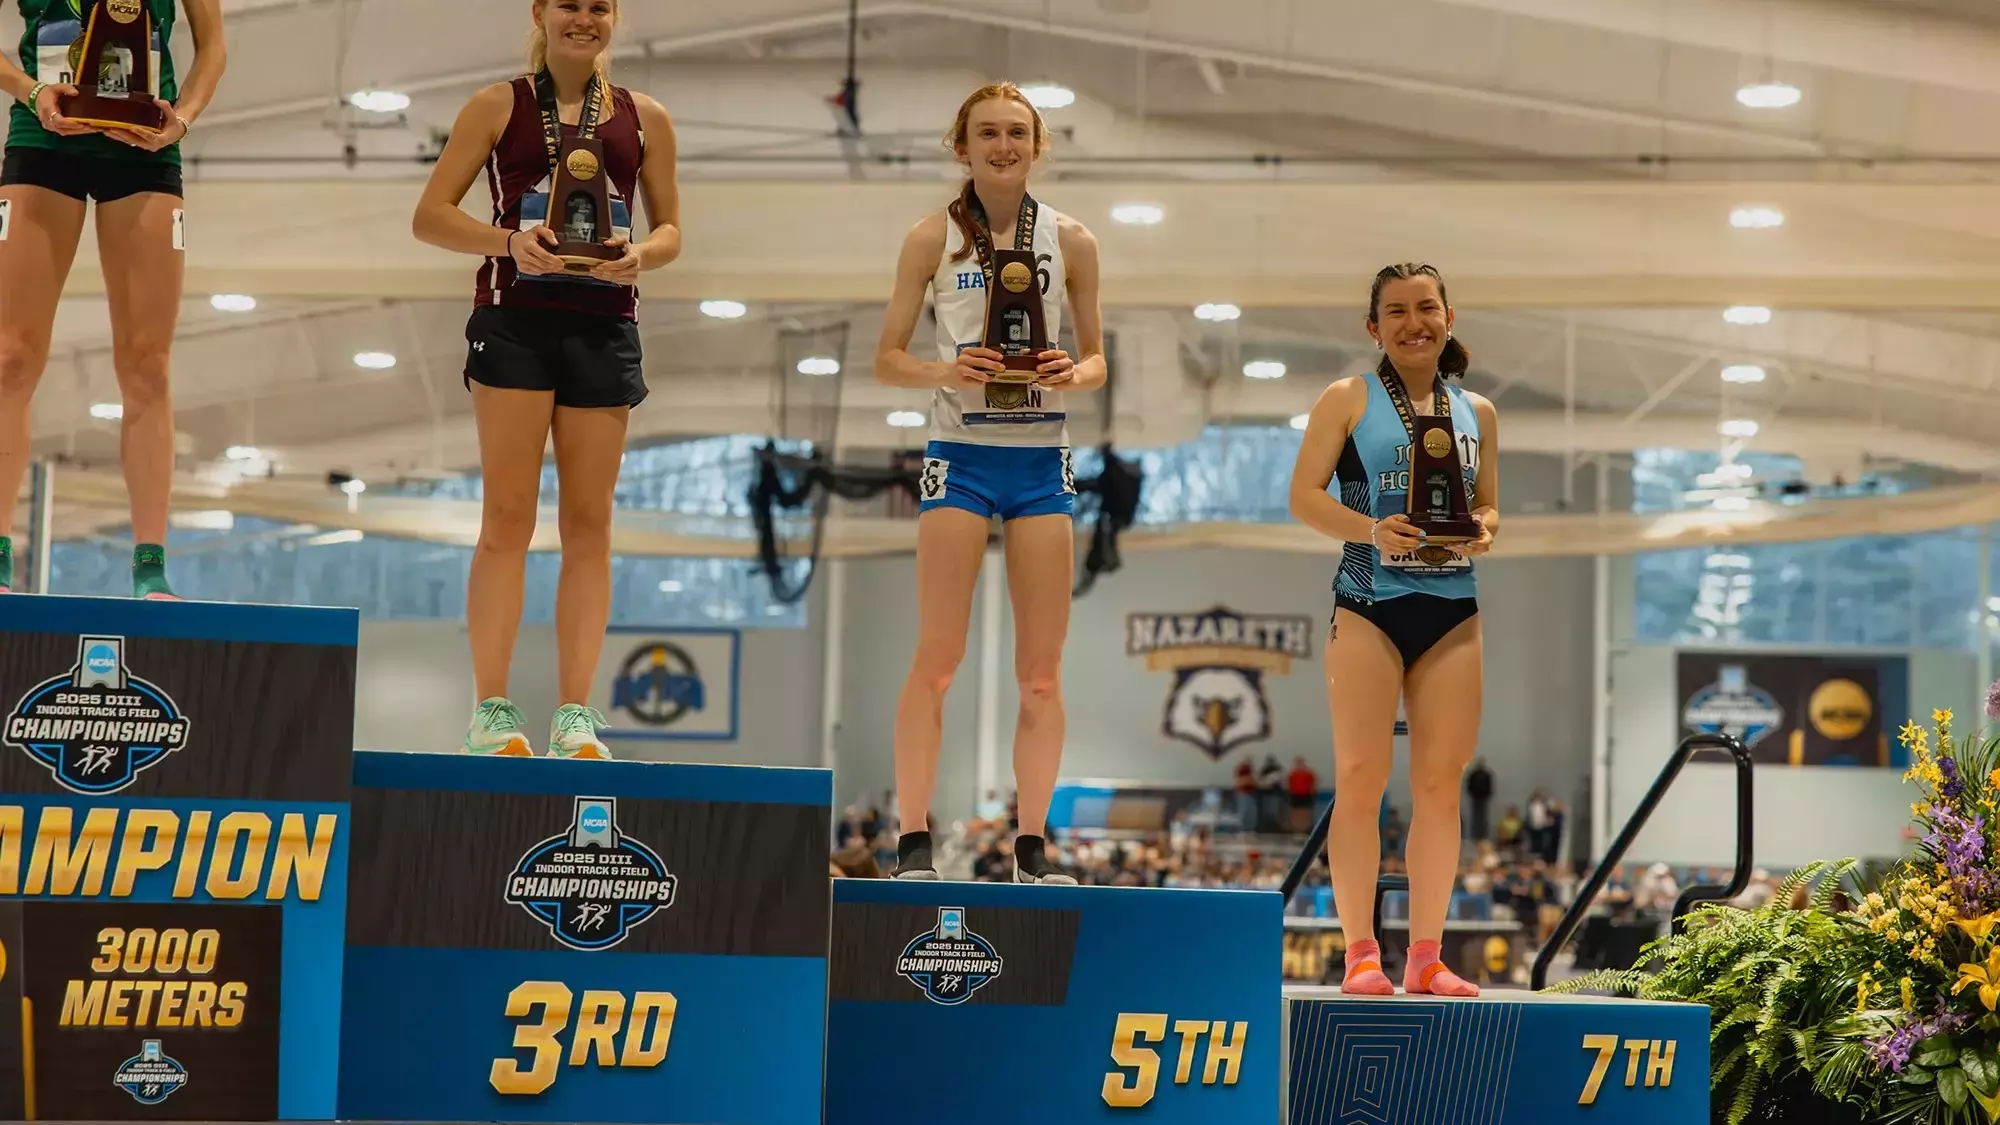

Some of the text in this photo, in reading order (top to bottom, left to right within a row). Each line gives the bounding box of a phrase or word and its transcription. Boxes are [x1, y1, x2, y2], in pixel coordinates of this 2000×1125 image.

[110, 3, 140, 14] NCAA
[923, 459, 941, 498] 6
[1131, 614, 1308, 654] NAZARETH
[89, 658, 115, 667] NCAA
[56, 693, 142, 706] 2025 DIII
[36, 705, 160, 718] INDOOR TRACK & FIELD
[10, 718, 183, 743] CHAMPIONSHIPS
[583, 818, 608, 827] NCAA
[553, 853, 632, 865] 2025 DIII
[535, 864, 649, 877] INDOOR TRACK & FIELD
[511, 876, 671, 901] CHAMPIONSHIPS
[91, 927, 220, 974] 3000
[954, 943, 975, 951] DIII
[900, 958, 1000, 973] CHAMPIONSHIPS
[59, 979, 248, 1027] METERS
[489, 980, 678, 1095] 3RD
[1101, 1012, 1249, 1108] 5TH
[1578, 1033, 1678, 1105] 7TH
[116, 1073, 186, 1083] CHAMPIONSHIPS
